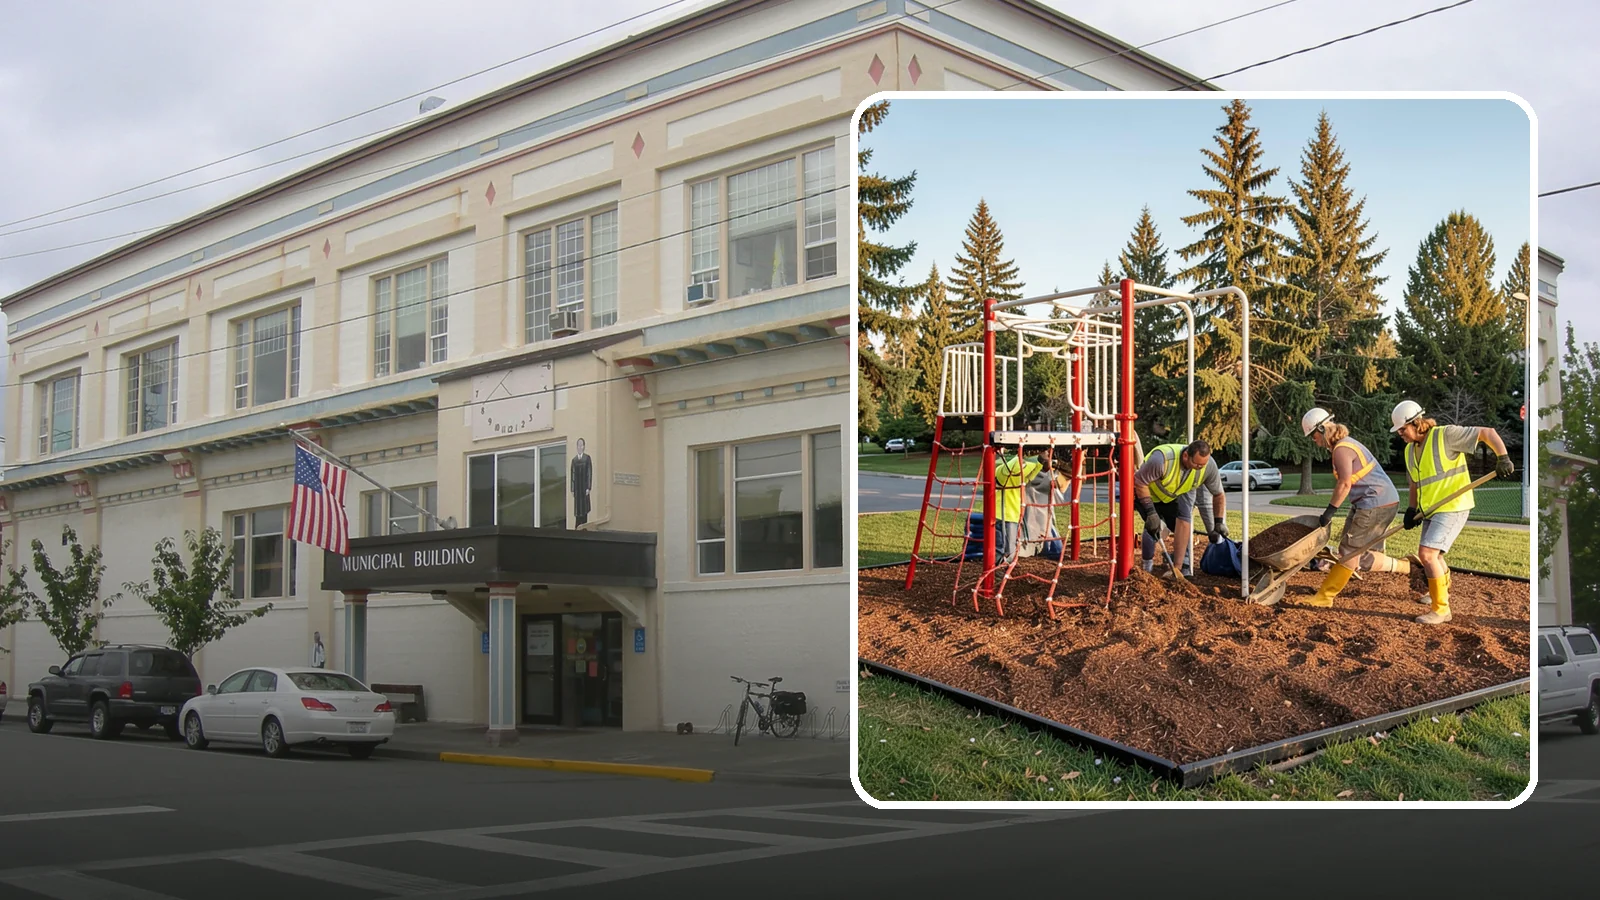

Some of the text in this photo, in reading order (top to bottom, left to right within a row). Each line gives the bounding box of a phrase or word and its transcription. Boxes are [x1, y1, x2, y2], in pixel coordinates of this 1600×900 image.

[488, 418, 492, 426] 9
[529, 414, 533, 422] 3
[495, 424, 500, 432] 10
[501, 426, 506, 434] 11
[507, 425, 513, 433] 12
[342, 546, 475, 572] MUNICIPAL BUILDING
